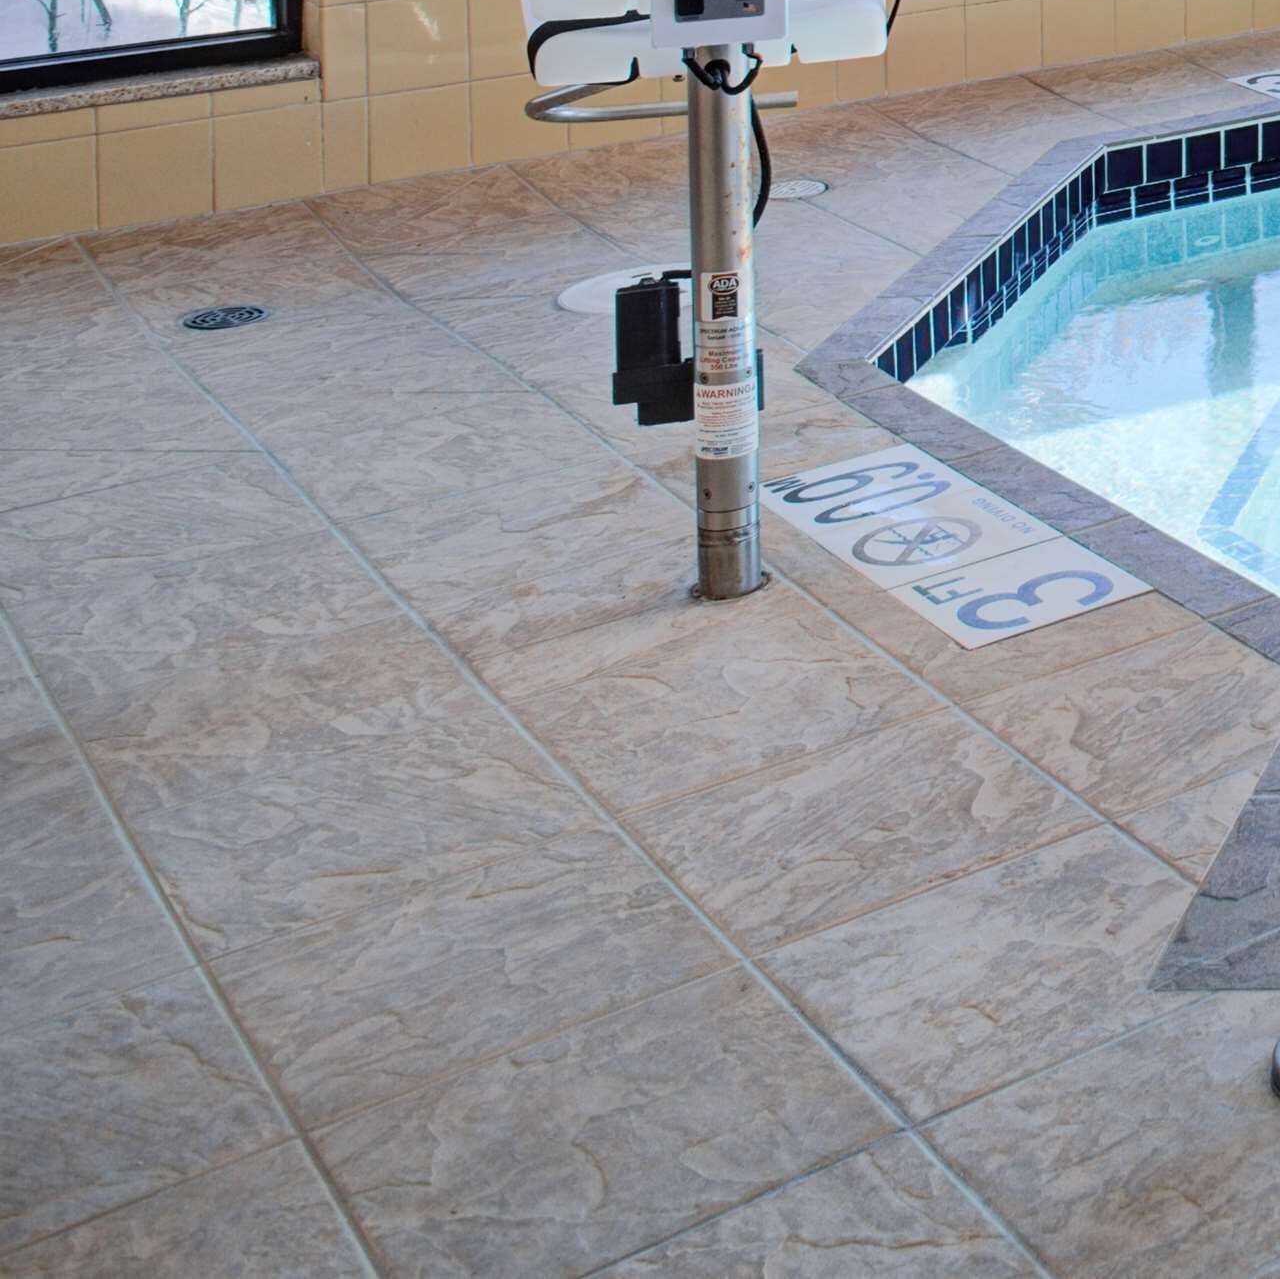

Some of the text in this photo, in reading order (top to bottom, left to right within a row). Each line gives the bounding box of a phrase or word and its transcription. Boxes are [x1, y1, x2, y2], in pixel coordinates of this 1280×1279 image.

[713, 278, 737, 289] ADA
[701, 384, 751, 399] WARNING
[912, 569, 1114, 630] 3 FT
